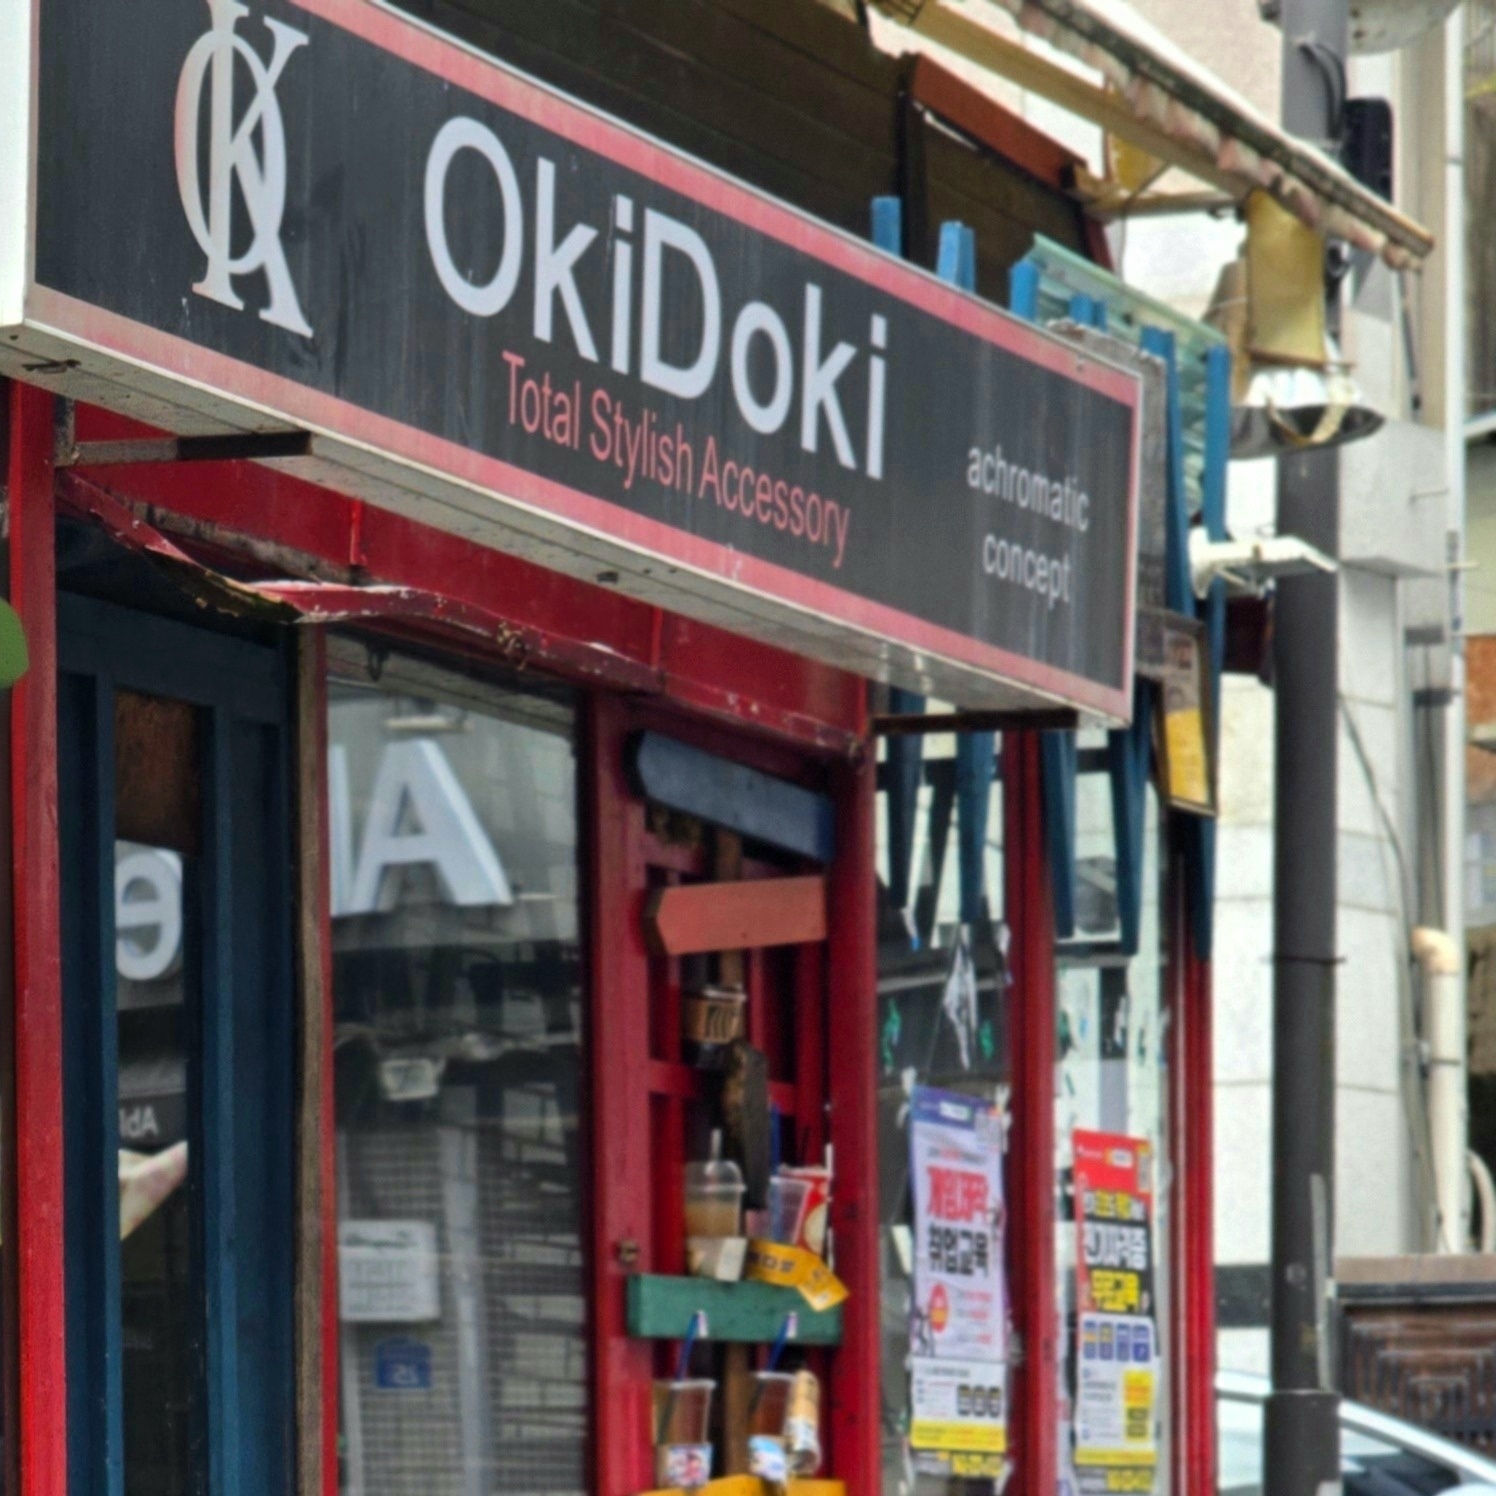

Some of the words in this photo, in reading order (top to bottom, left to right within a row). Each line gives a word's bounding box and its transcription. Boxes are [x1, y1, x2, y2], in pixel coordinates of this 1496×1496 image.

[422, 114, 889, 480] OkiDoki
[500, 350, 581, 449] Total
[589, 388, 694, 492] Stylish
[698, 432, 851, 570] Accessory
[966, 440, 1090, 530] achromatic
[980, 528, 1073, 612] concept
